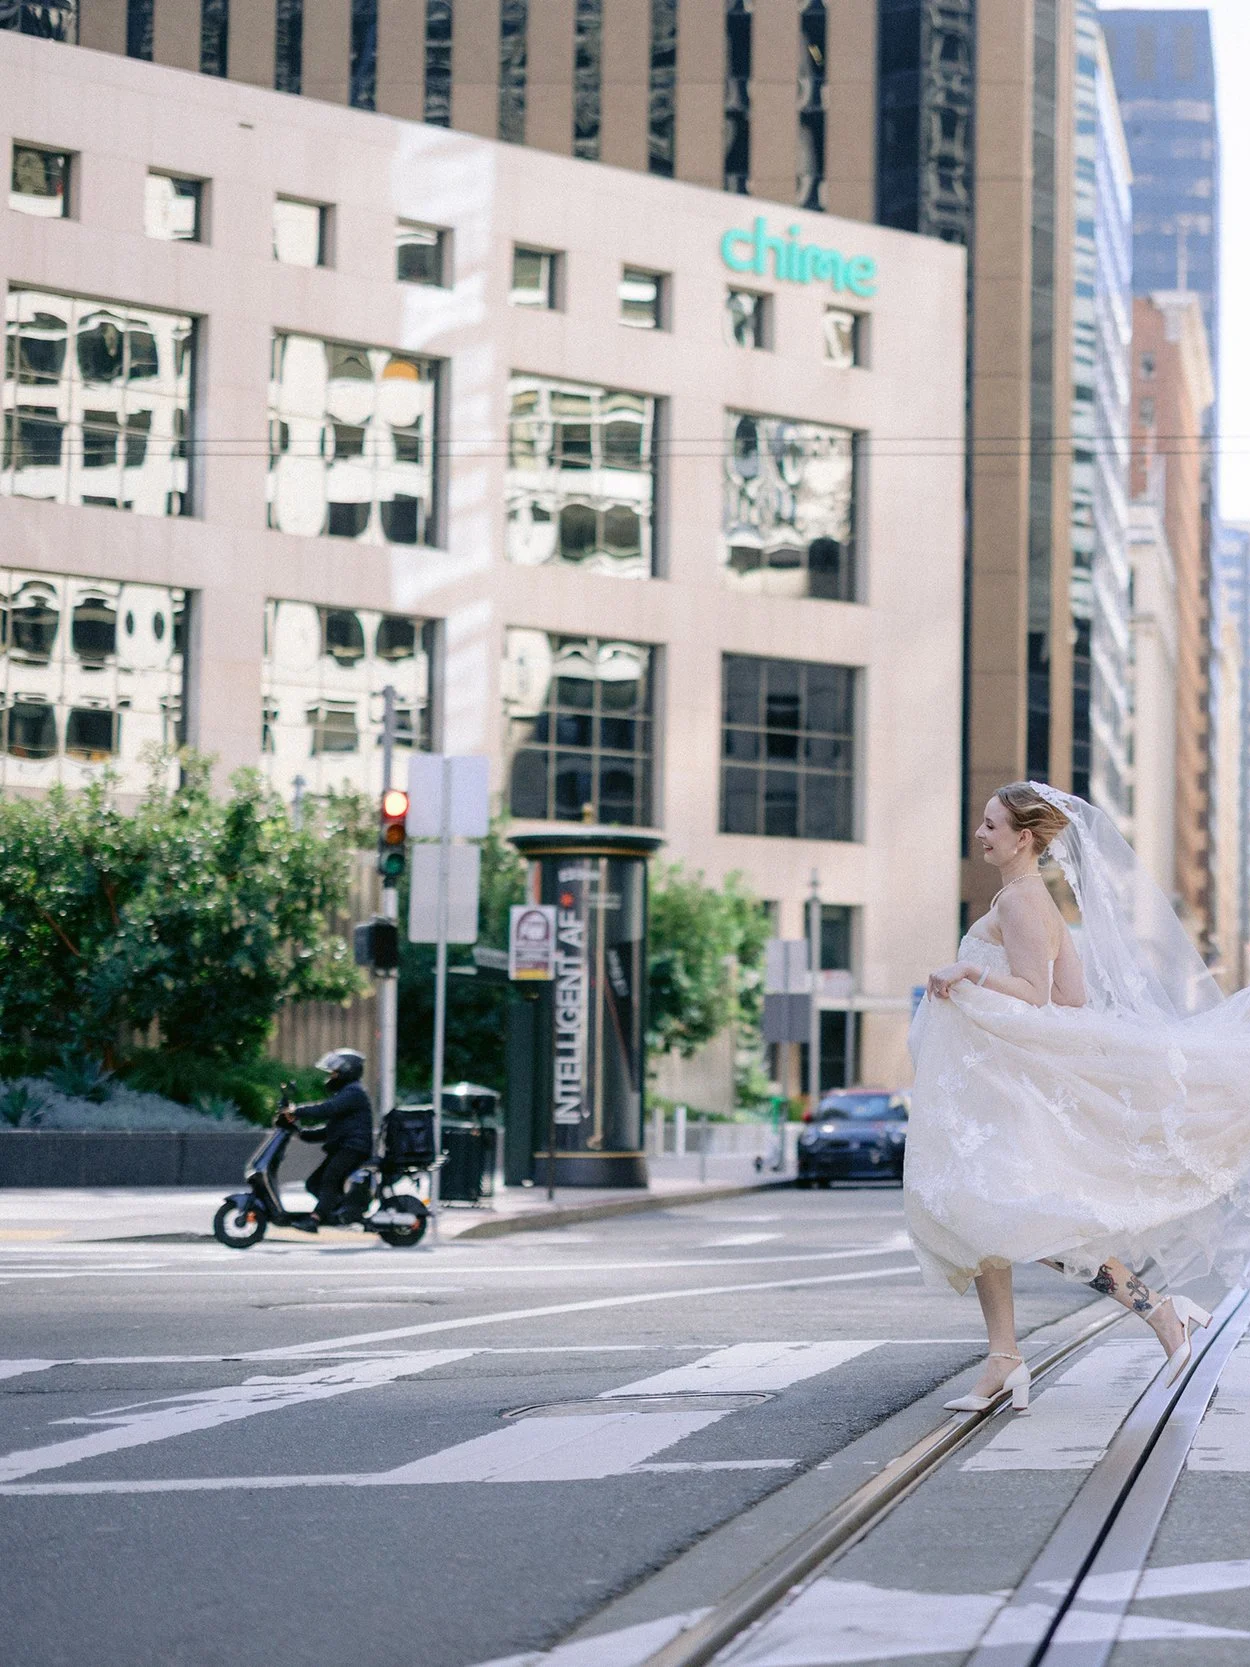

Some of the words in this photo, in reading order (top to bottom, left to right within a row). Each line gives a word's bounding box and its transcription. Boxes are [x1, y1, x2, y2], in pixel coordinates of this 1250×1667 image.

[720, 216, 877, 297] chime
[558, 911, 585, 948] AF
[553, 950, 585, 1124] INTELLIGENT
